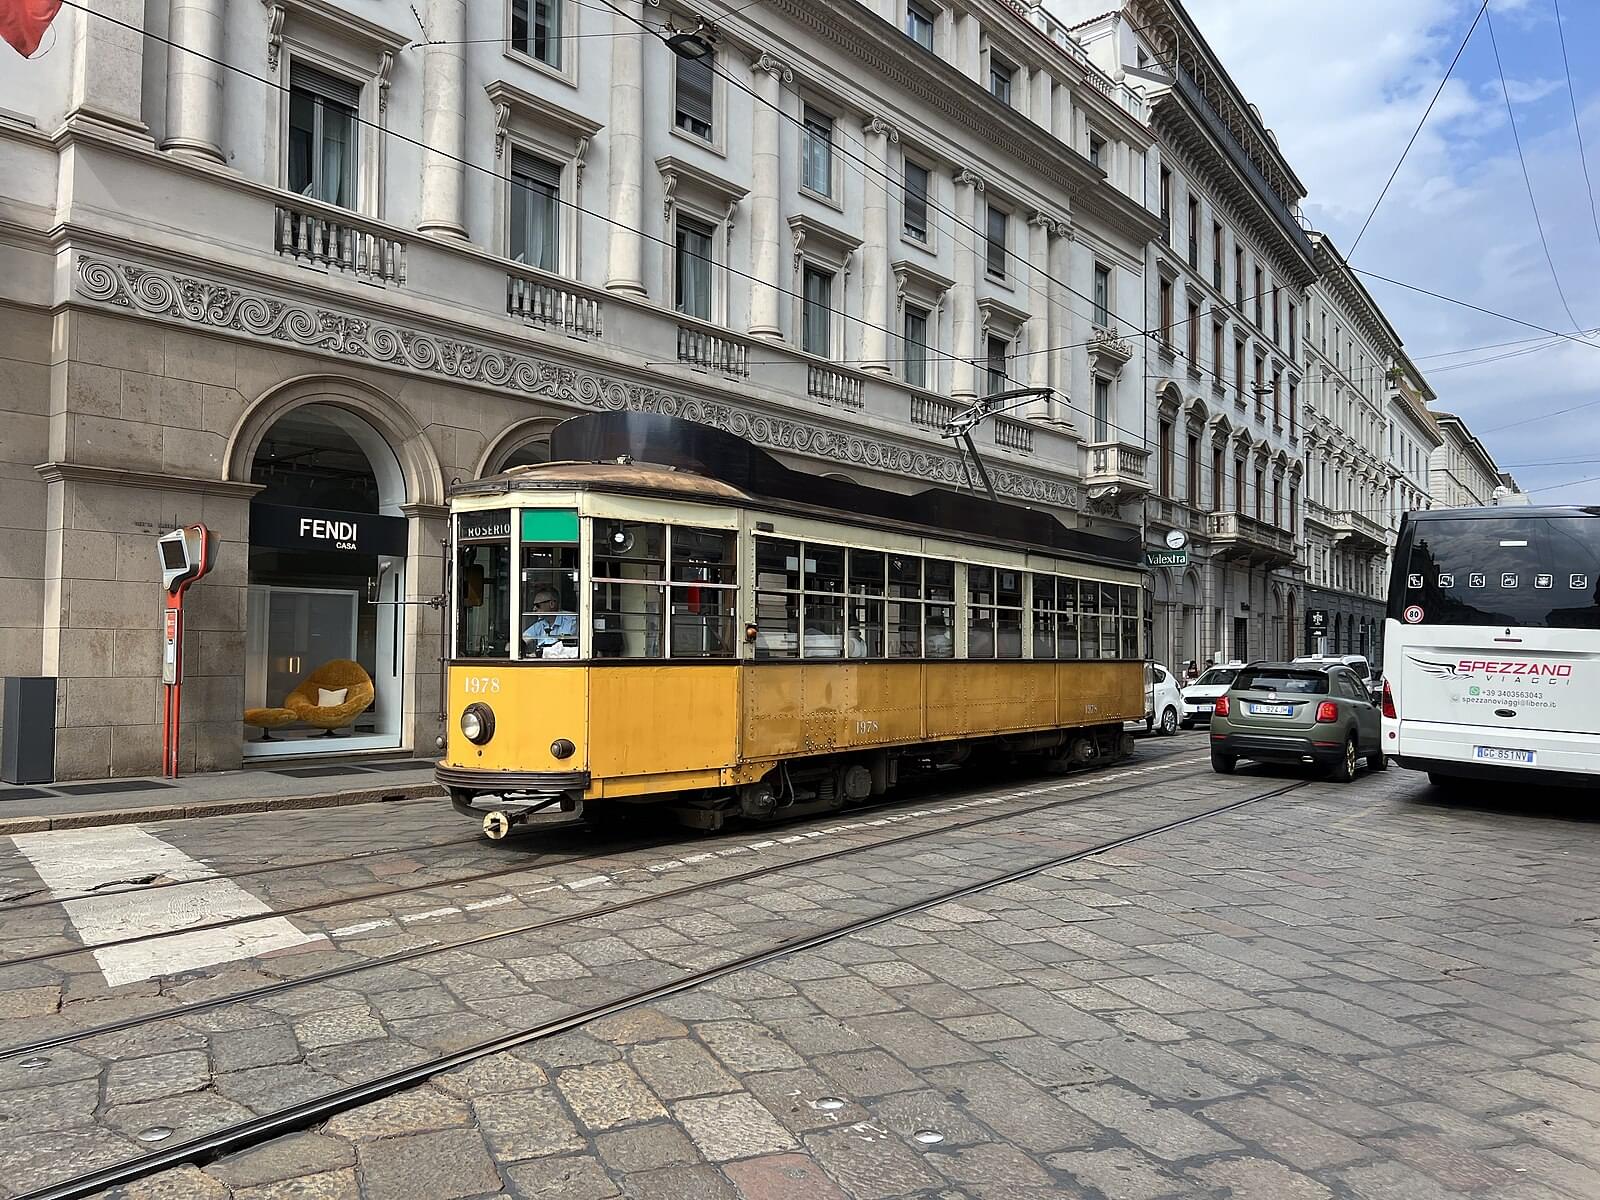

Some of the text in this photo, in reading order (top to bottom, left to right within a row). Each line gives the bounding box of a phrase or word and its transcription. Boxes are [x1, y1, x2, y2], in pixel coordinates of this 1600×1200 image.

[300, 518, 357, 541] FENDI
[336, 541, 357, 550] CASA
[1147, 553, 1186, 565] Valextra
[1409, 610, 1419, 618] 80
[1458, 660, 1572, 677] SPEZZANO
[465, 676, 501, 694] 1978
[1486, 675, 1570, 685] VIAGGI
[1482, 689, 1496, 697] +39
[856, 720, 879, 735] 1978
